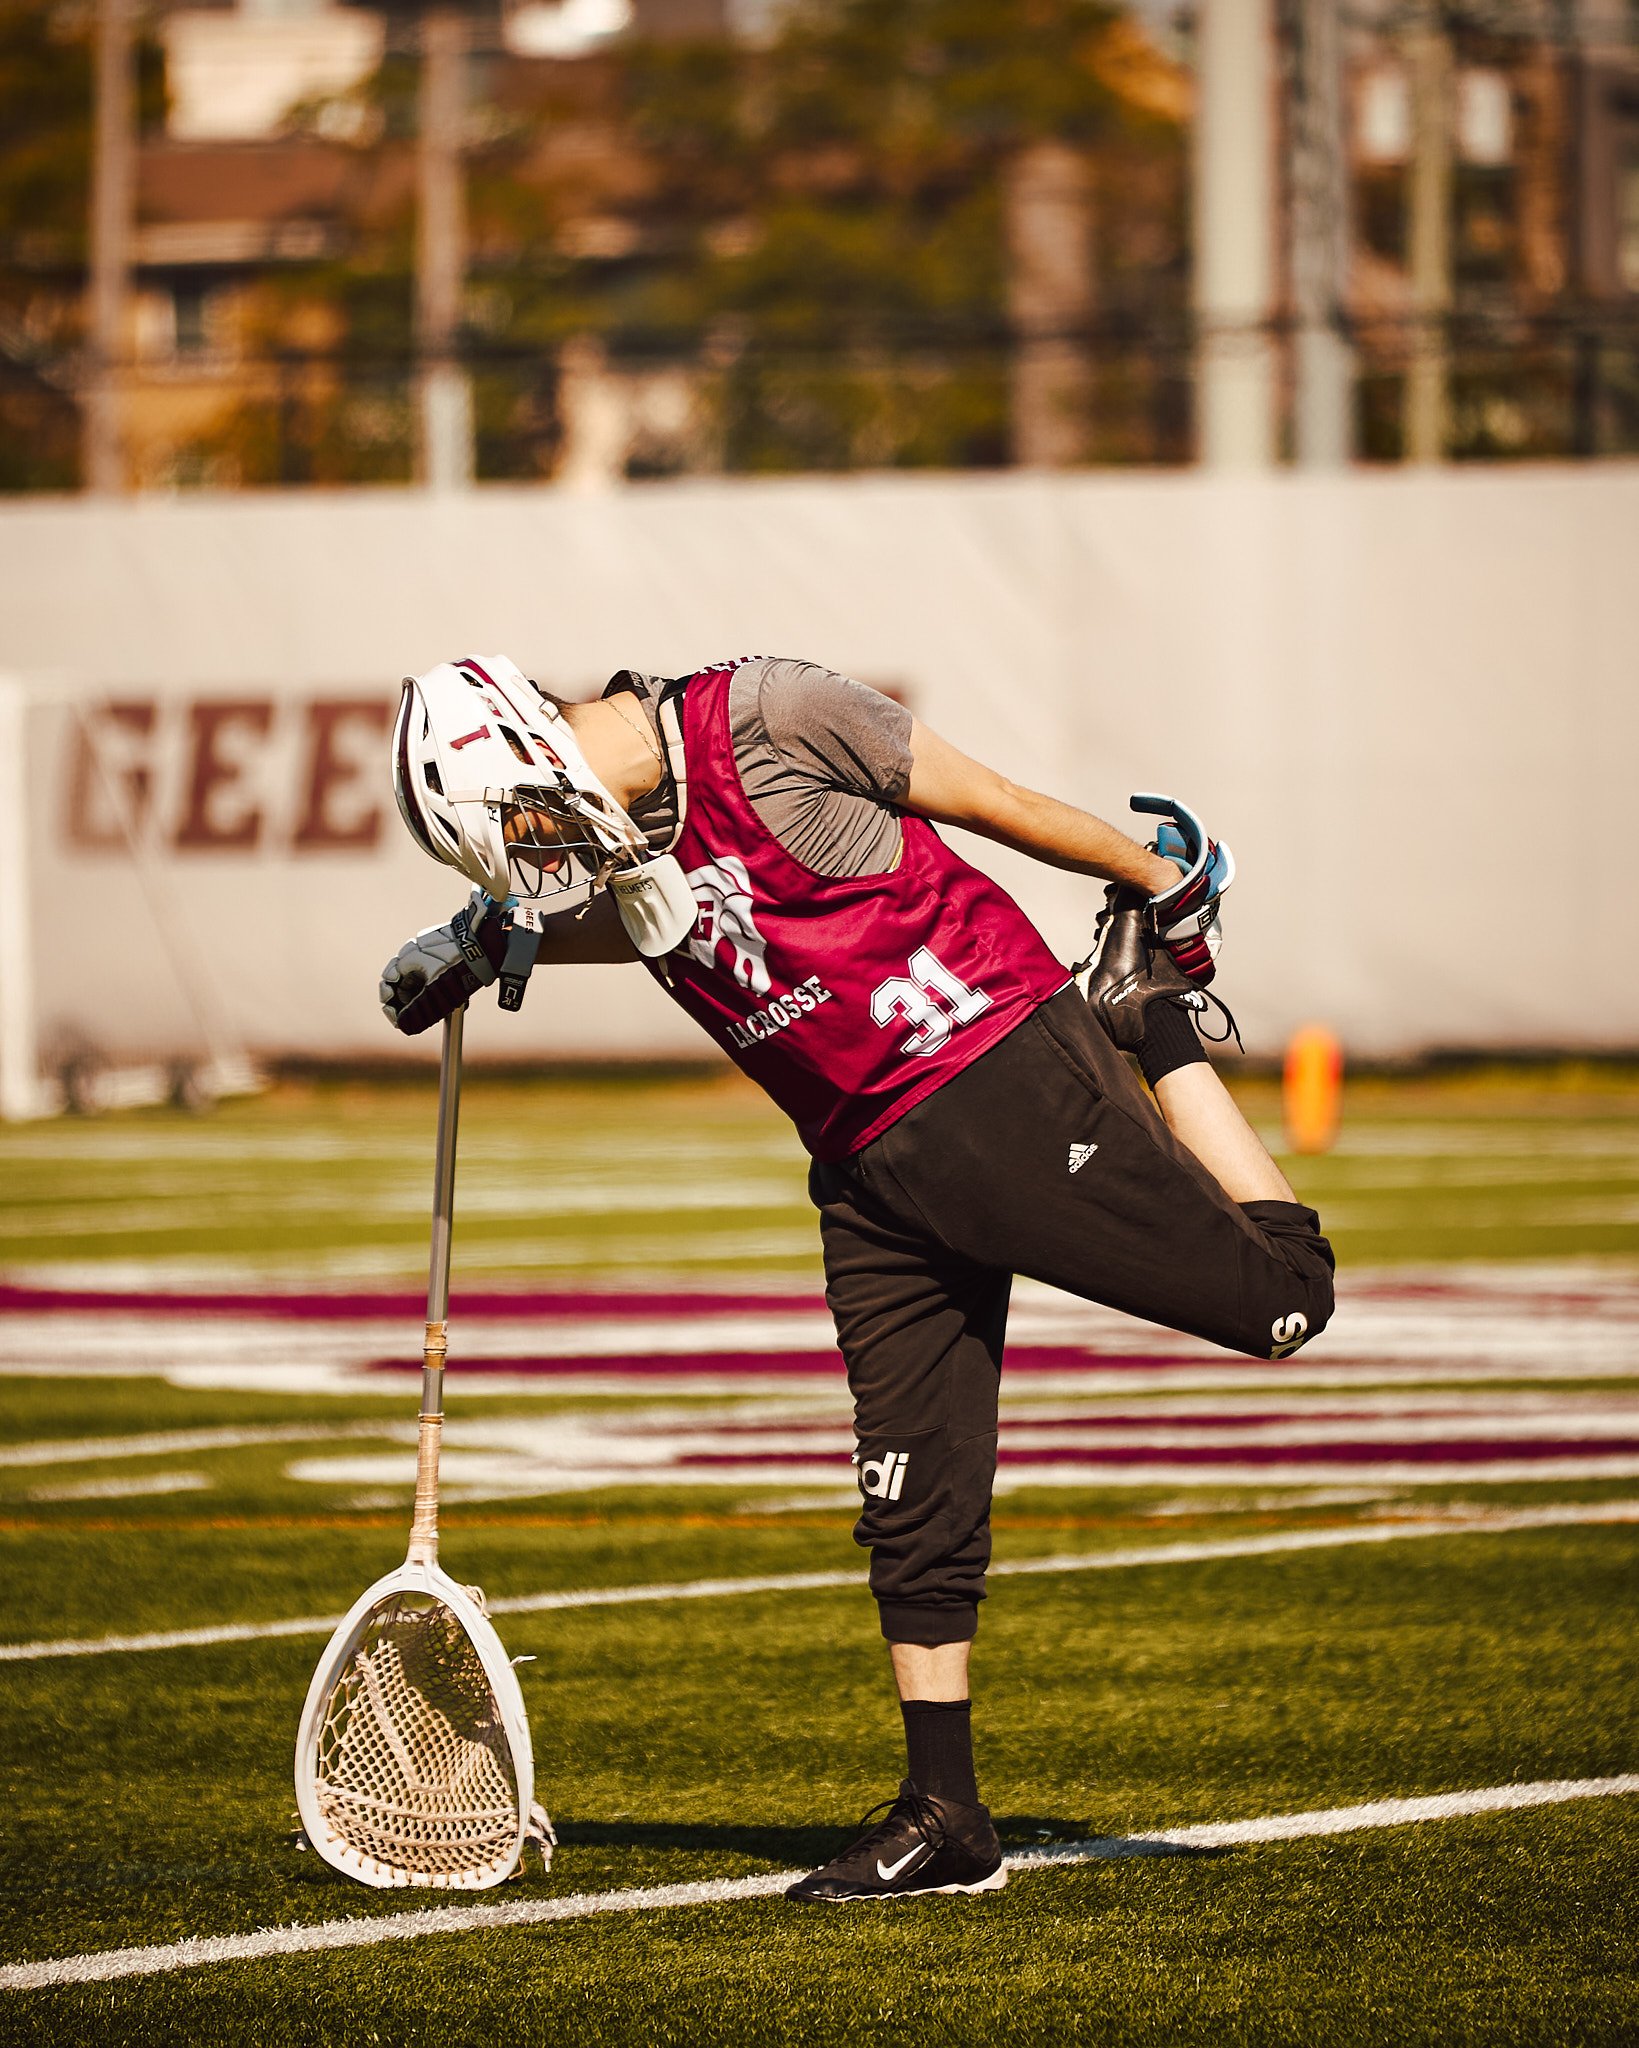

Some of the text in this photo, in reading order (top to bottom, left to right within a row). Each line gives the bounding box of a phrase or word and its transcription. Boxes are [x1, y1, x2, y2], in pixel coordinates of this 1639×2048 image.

[448, 724, 492, 751] 1
[619, 879, 653, 896] HELMETS
[725, 974, 833, 1049] LACROSSE
[869, 944, 995, 1057] 31
[1068, 1143, 1099, 1174] adidas
